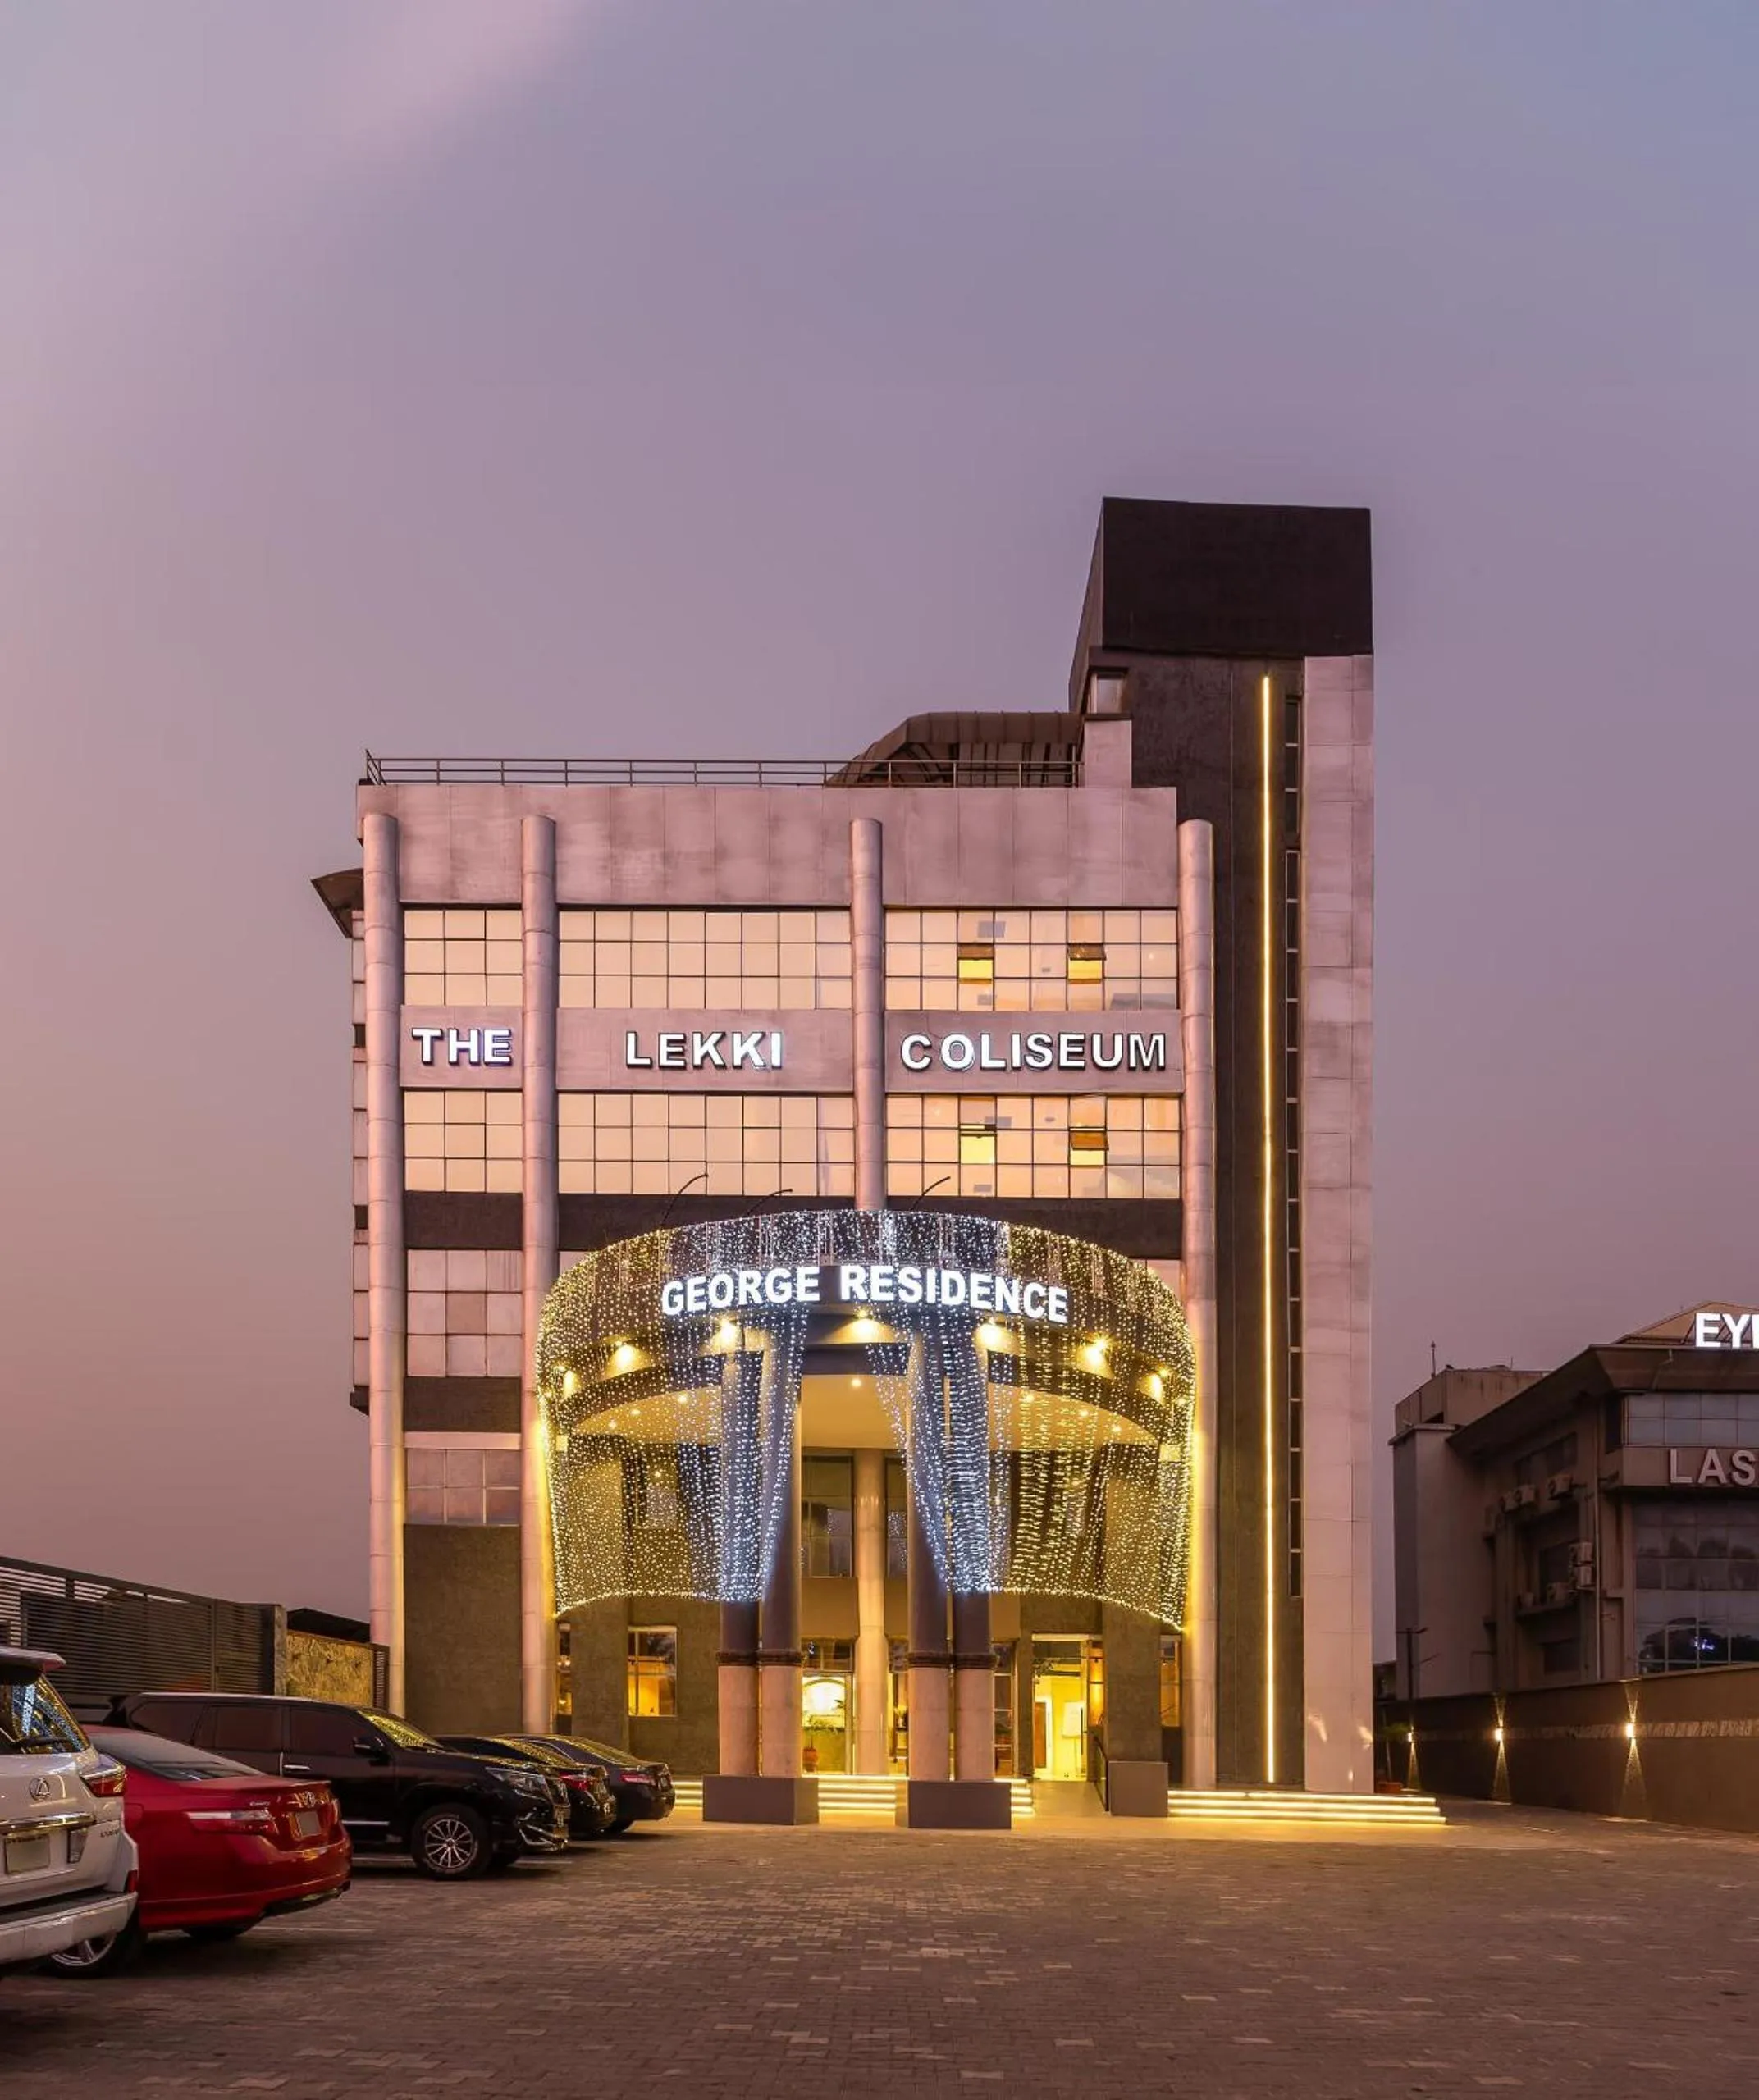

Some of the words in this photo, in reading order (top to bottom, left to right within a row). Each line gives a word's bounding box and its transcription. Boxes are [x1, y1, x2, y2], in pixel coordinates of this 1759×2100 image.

[411, 1028, 513, 1066] THE
[625, 1031, 783, 1068] LEKKI
[900, 1033, 1167, 1071] COLISEUM
[661, 1267, 820, 1315] GEORGE
[839, 1265, 1068, 1322] RESIDENCE
[1670, 1449, 1756, 1486] LAS
